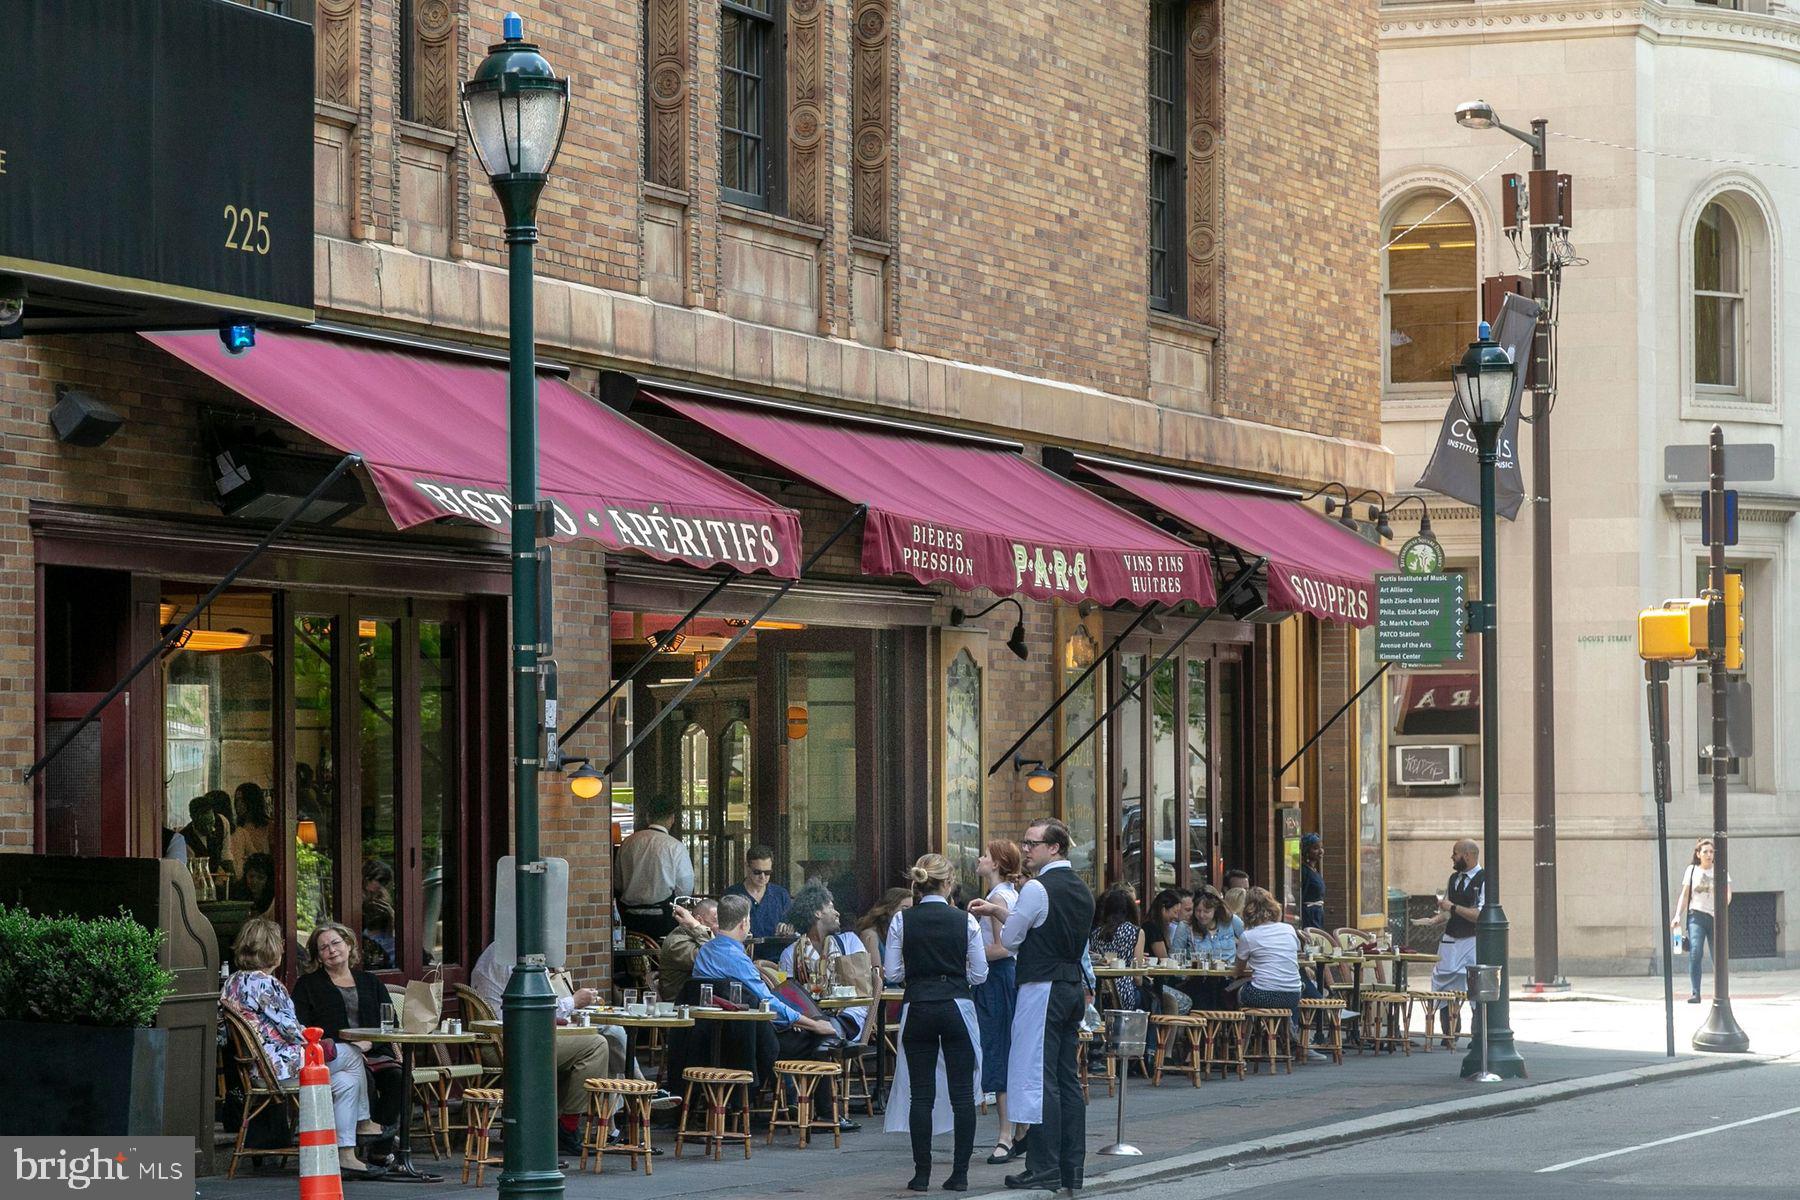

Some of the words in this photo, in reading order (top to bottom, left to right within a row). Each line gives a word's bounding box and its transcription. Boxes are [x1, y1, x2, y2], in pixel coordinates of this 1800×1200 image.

[224, 205, 271, 255] 225
[416, 482, 579, 536] BISTO
[608, 507, 779, 568] APÉRITIFS
[913, 523, 963, 551] BIÈRES
[903, 548, 974, 576] PRESSION
[1123, 555, 1154, 572] VINS
[1157, 556, 1184, 573] FINS
[1291, 575, 1369, 620] SOUPERS
[1577, 634, 1604, 643] LOCUST
